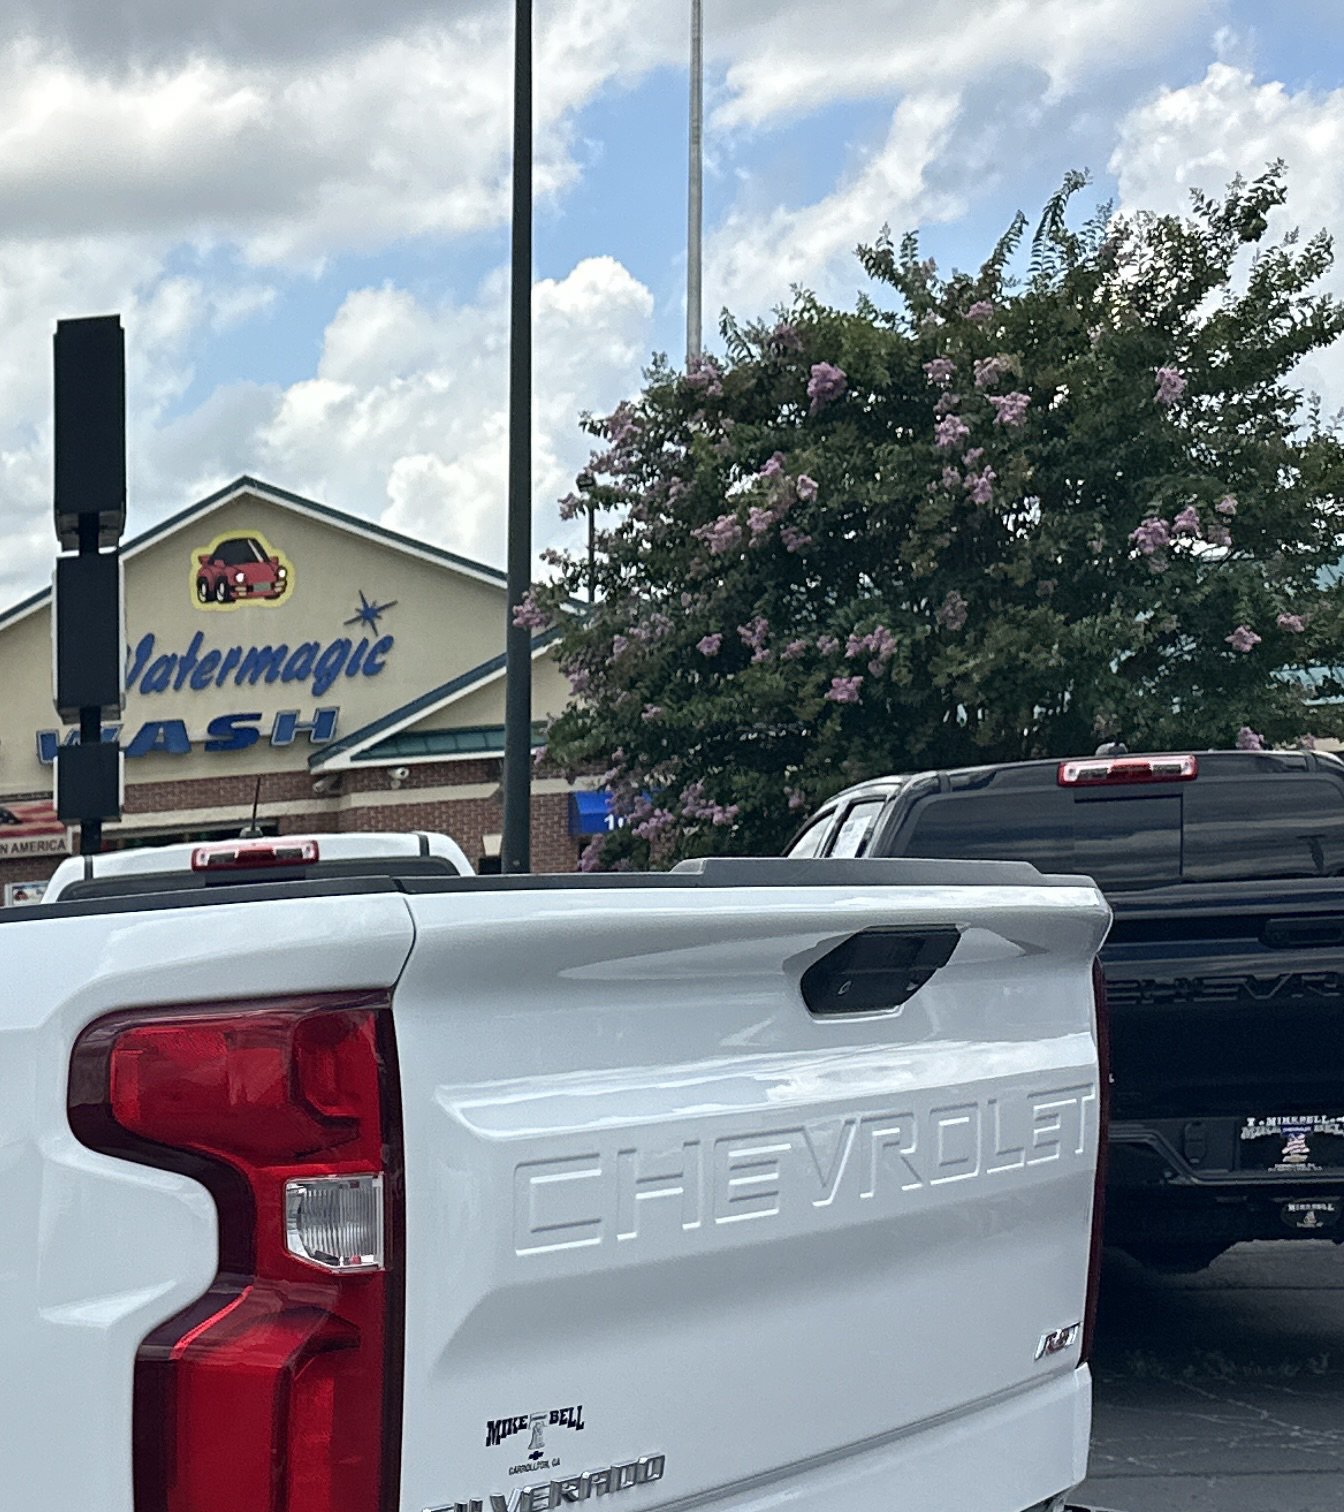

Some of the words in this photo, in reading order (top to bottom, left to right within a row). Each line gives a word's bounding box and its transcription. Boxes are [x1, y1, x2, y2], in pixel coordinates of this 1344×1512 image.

[10, 838, 67, 854] AMERICA
[514, 1084, 1095, 1257] CHEVROLET
[485, 1414, 529, 1447] MIKE
[549, 1405, 585, 1431] BELL
